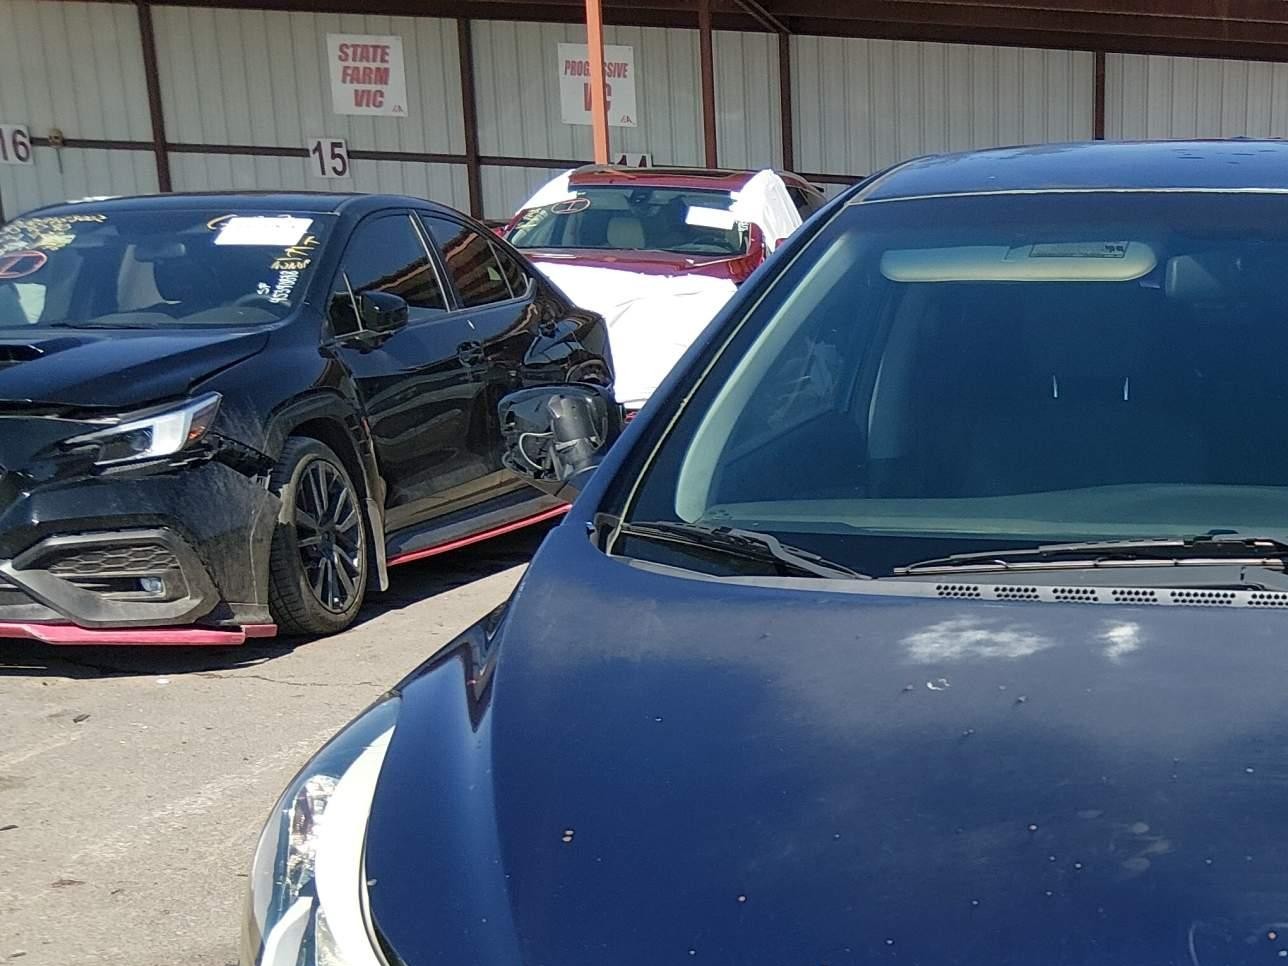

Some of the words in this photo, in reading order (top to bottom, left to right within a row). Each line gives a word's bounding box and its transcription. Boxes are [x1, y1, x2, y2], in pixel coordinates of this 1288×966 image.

[338, 43, 391, 64] STATE
[341, 65, 391, 86] FARM
[564, 59, 629, 79] PROGSIVE
[353, 88, 385, 109] VIC
[583, 82, 612, 113] VC
[0, 127, 30, 163] 16
[312, 140, 347, 177] 15
